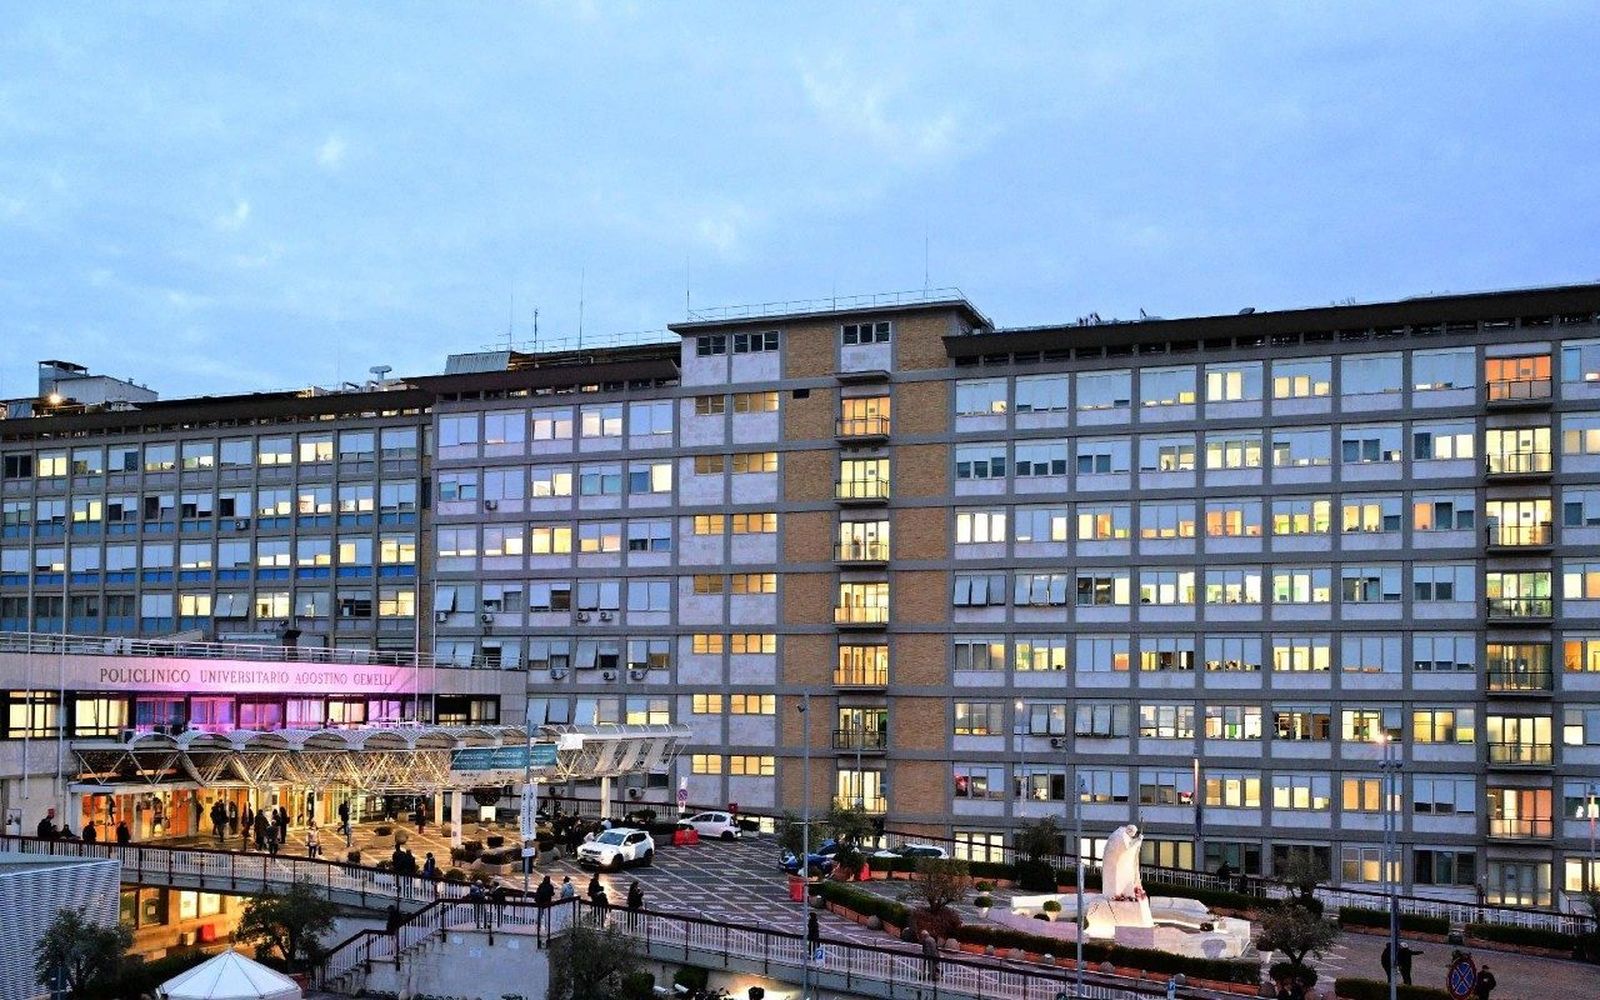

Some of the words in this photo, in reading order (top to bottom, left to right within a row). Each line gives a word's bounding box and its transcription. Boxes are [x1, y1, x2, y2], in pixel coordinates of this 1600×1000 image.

[100, 668, 191, 683] POLICLINICO
[200, 670, 290, 684] UNIVERSITARIO
[295, 672, 348, 685] AGOSTINO
[353, 673, 393, 686] GEMELLI
